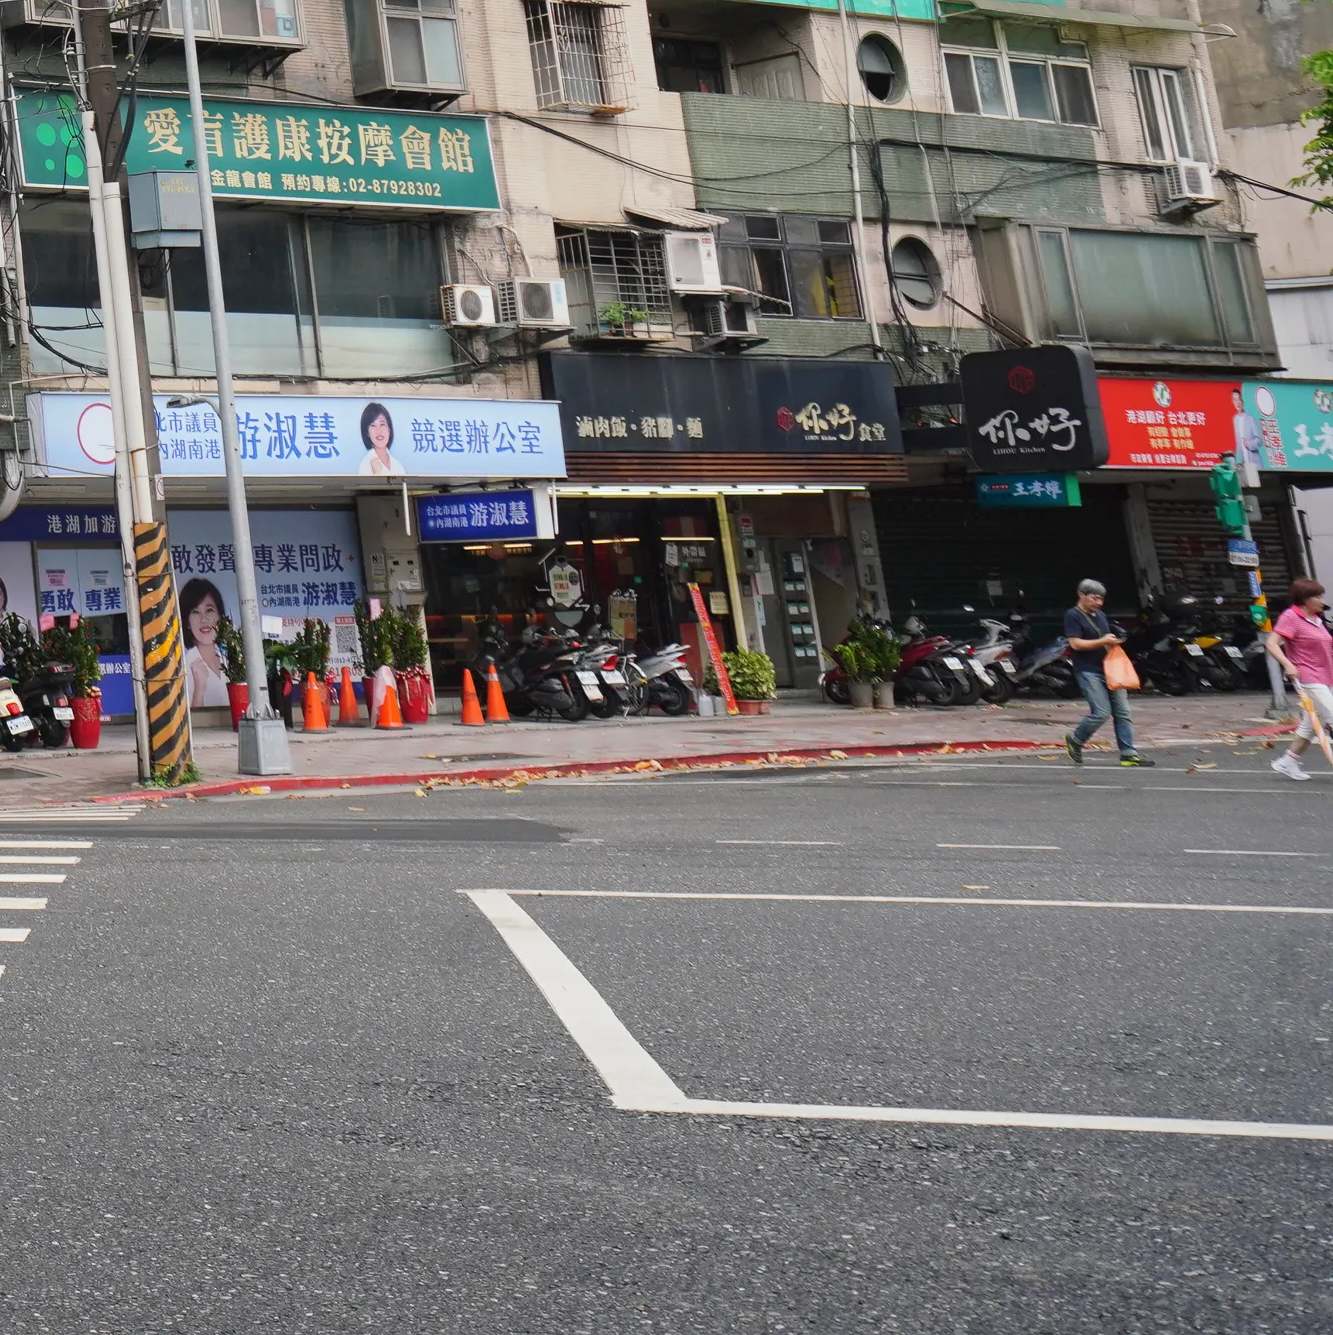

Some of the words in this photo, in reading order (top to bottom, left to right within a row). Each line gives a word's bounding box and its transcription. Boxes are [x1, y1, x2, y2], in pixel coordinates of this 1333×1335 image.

[410, 418, 544, 455] 競選辦公室
[859, 423, 887, 442] 食堂
[426, 504, 467, 517] 台北市議員
[469, 501, 529, 527] 游淑慧
[46, 514, 117, 534] 港湖加游
[436, 517, 468, 529] 內湖南港
[253, 544, 344, 574] 專業問政
[40, 588, 75, 613] 勇敢
[84, 587, 122, 612] 專業
[261, 584, 299, 596] 台北市議員
[301, 581, 357, 607] 游淑慧
